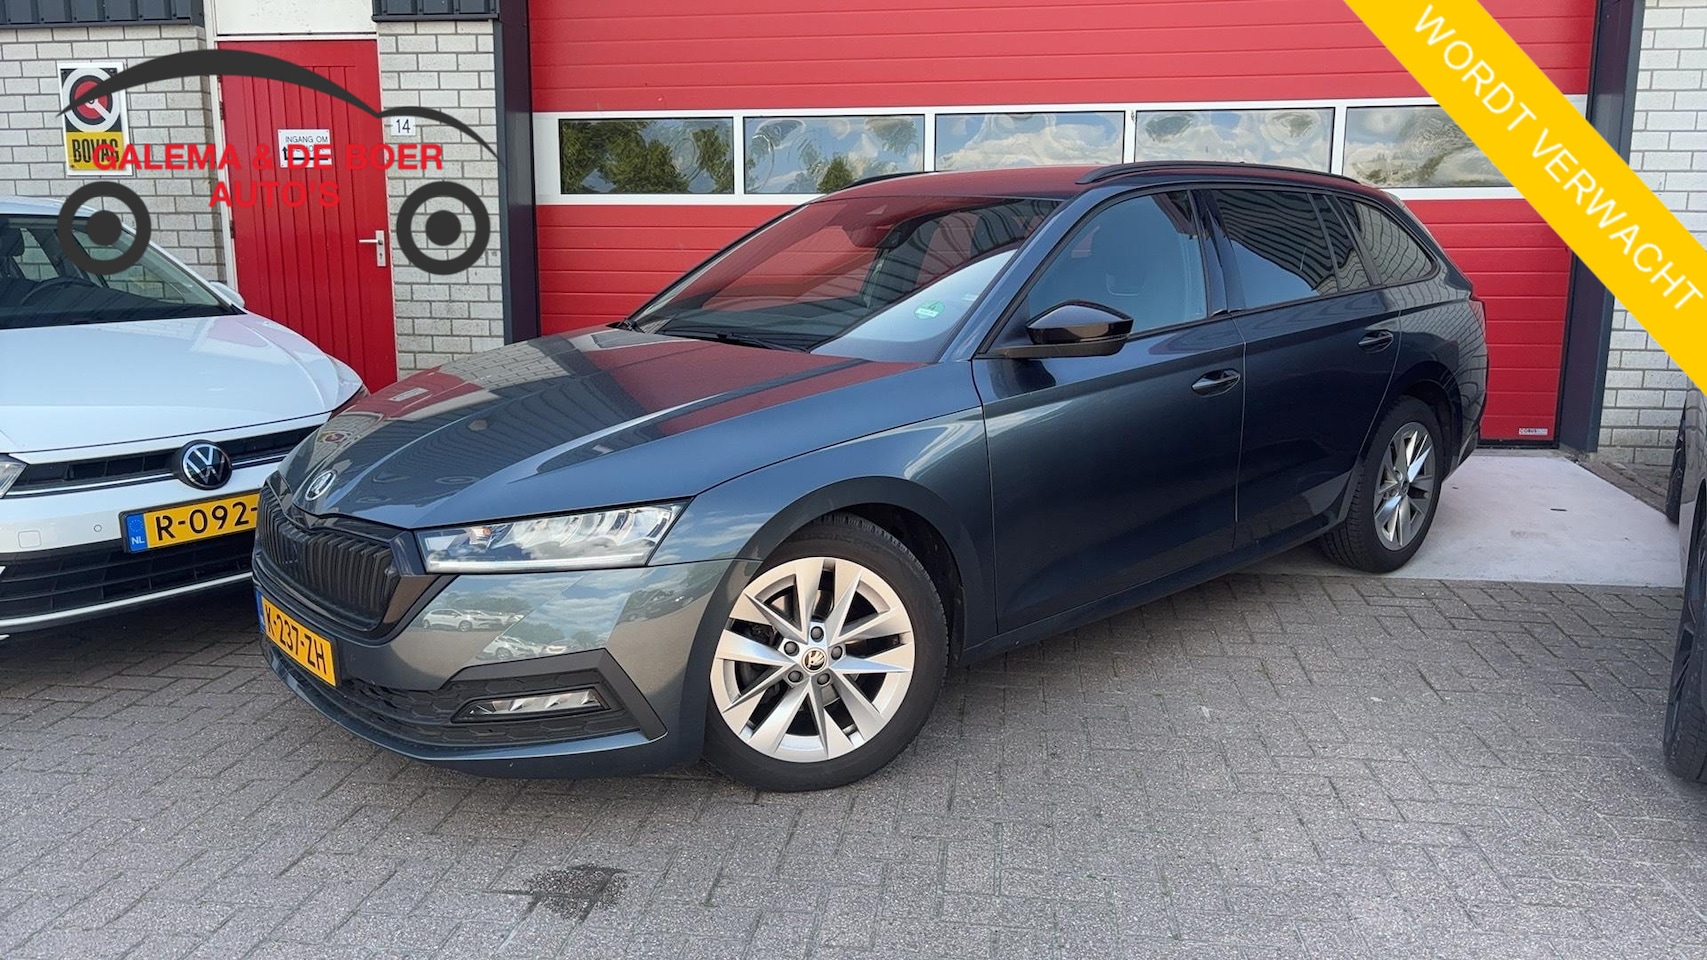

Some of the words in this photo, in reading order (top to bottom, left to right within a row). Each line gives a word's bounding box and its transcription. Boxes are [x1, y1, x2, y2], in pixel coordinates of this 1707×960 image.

[394, 118, 412, 135] 14
[285, 135, 314, 143] INGANG
[315, 135, 328, 143] OM
[131, 535, 146, 546] NL
[266, 604, 328, 675] K-237-ZH
